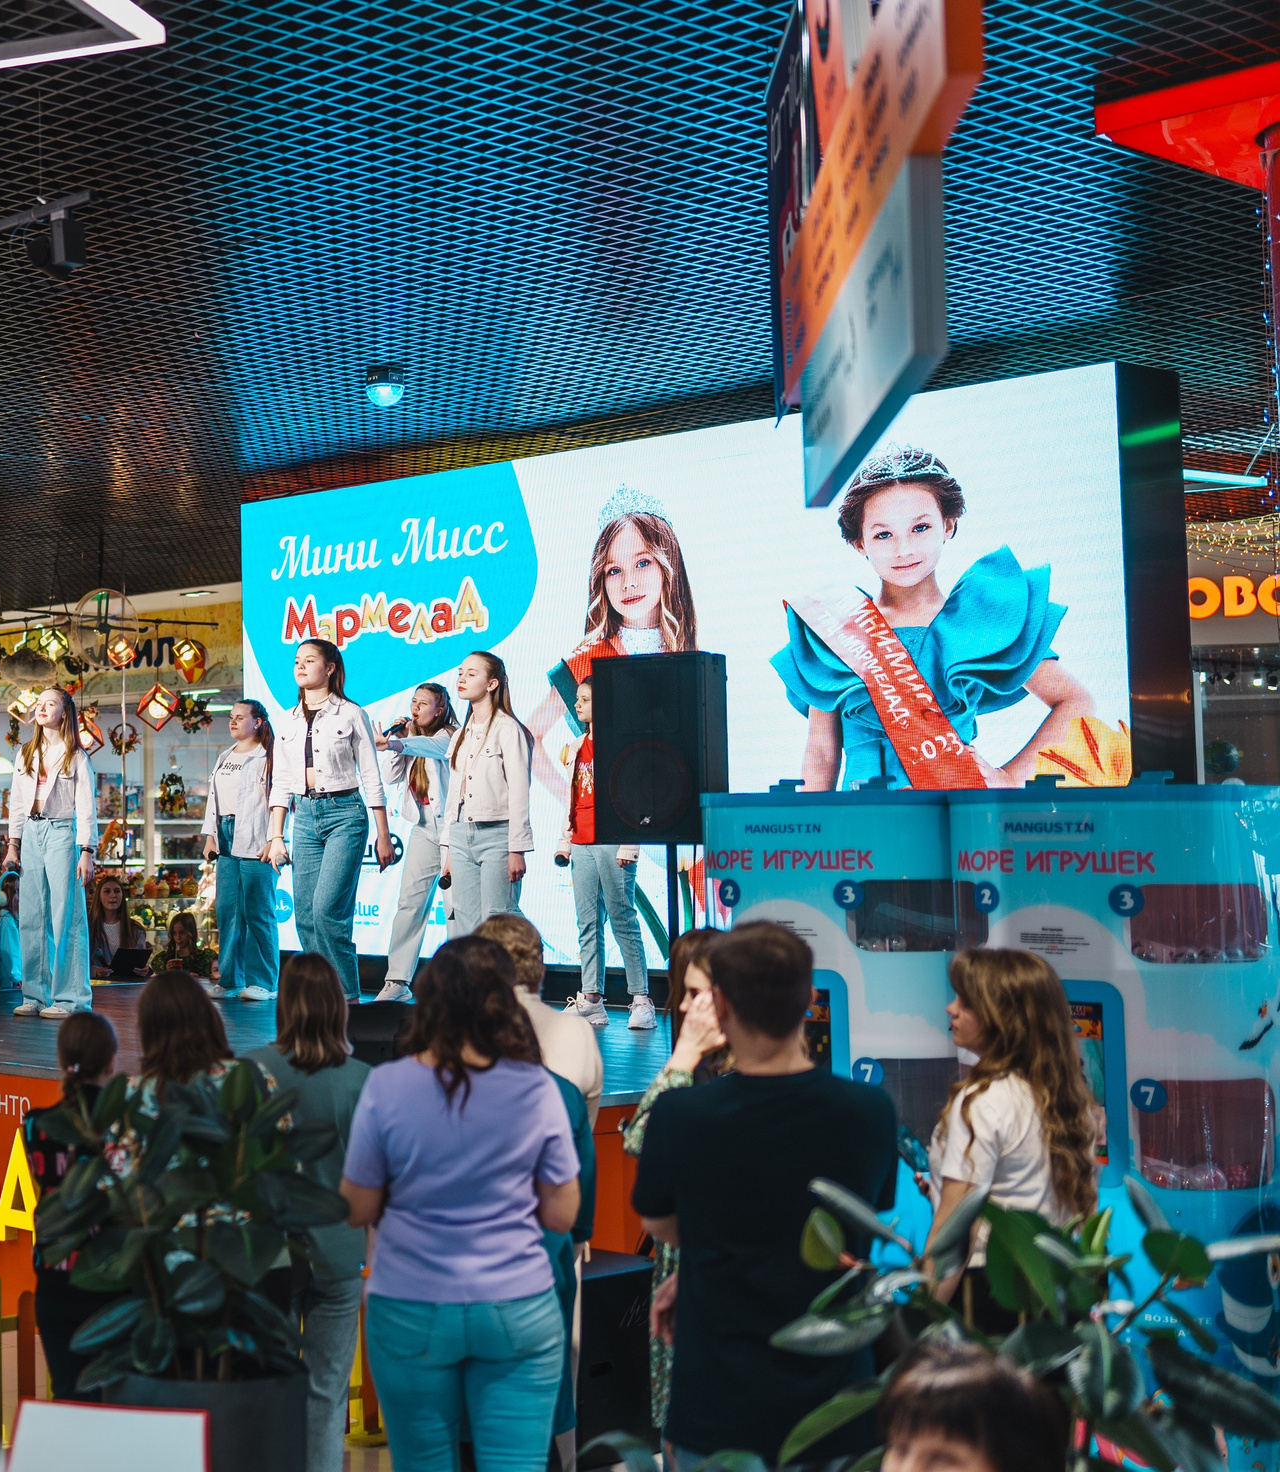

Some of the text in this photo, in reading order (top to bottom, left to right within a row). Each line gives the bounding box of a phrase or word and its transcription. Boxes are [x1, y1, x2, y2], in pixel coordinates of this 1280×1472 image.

[271, 516, 509, 581] Мини Мисс
[745, 823, 821, 834] MANGUSTIN
[1004, 821, 1095, 834] MANGUSTIN
[707, 849, 874, 872] МОРЕ ИГРУШЕК
[958, 849, 1156, 874] МОРЕ ИГРУШЕК
[724, 885, 735, 900] 2
[842, 885, 855, 903] 3
[980, 888, 992, 905] 2
[1119, 891, 1135, 910] 3
[860, 1063, 874, 1083] 7
[1140, 1085, 1156, 1107] 7
